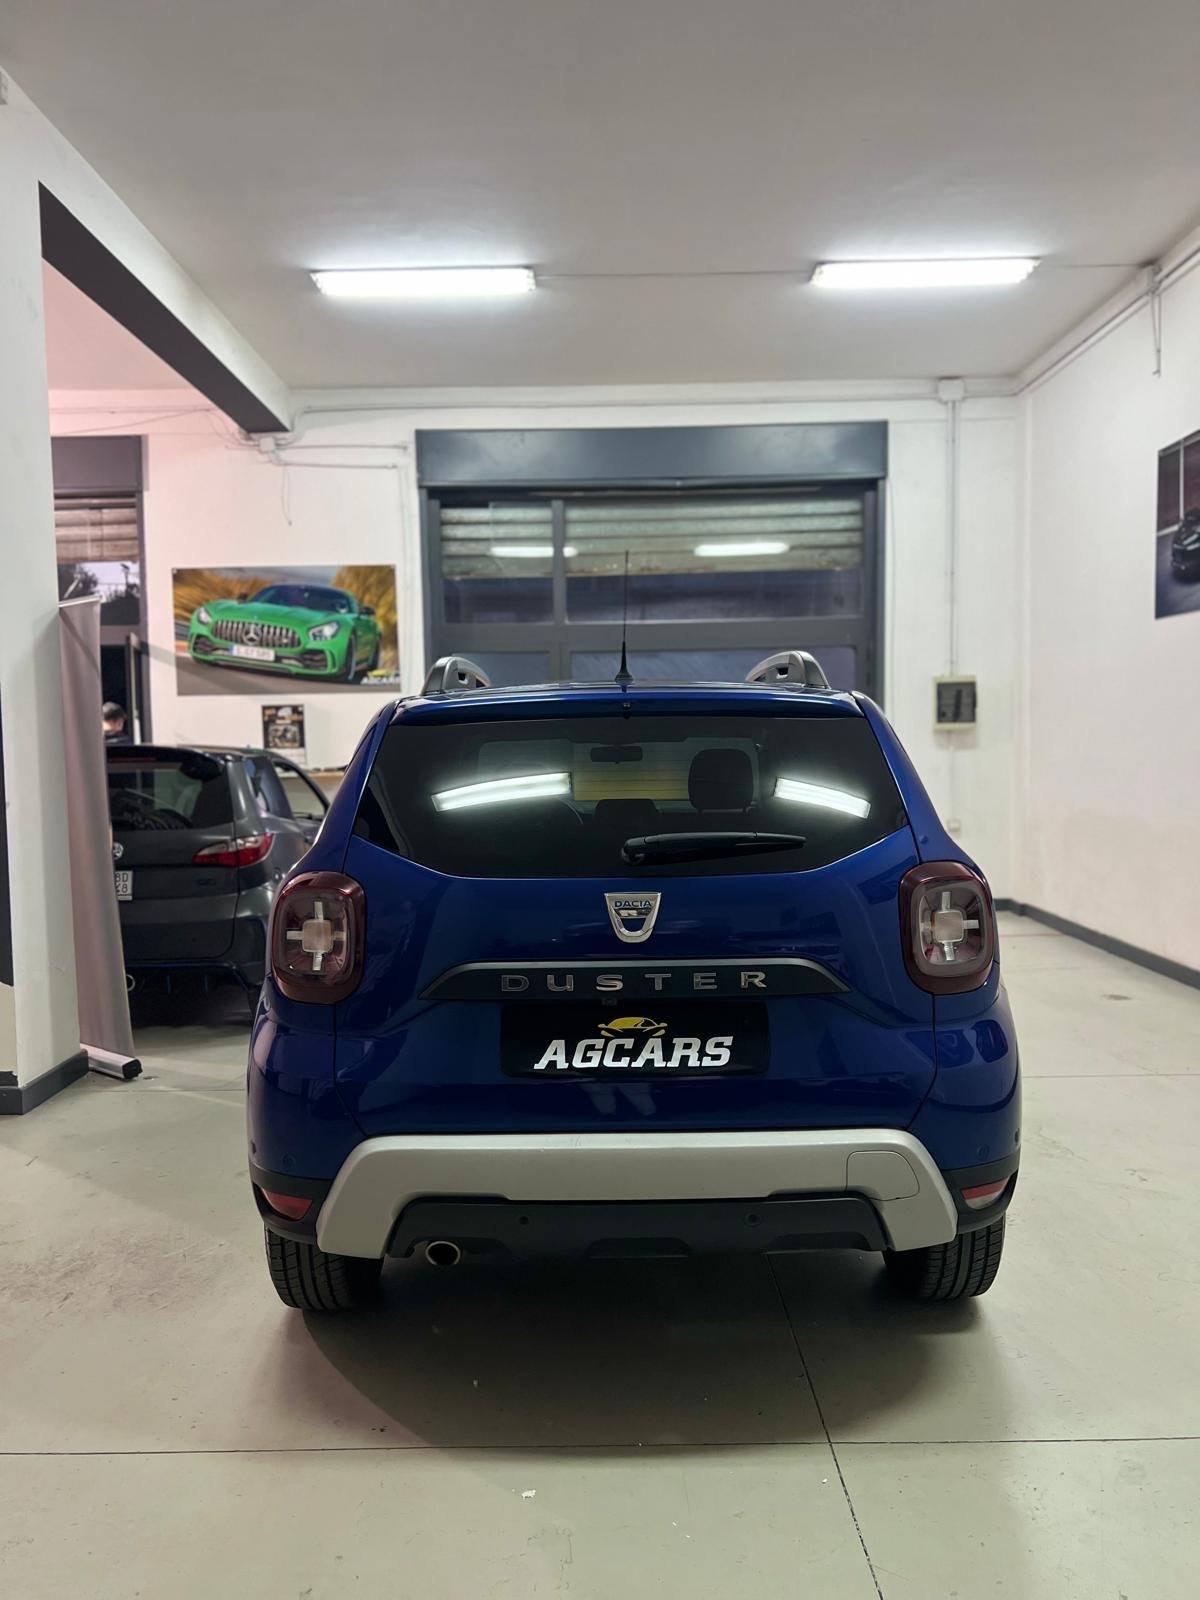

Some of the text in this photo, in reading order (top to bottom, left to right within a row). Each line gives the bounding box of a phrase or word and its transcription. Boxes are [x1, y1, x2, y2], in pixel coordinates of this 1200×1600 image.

[614, 900, 652, 908] DACIA
[501, 971, 768, 992] DUSTER
[533, 1036, 734, 1070] AGCARS
